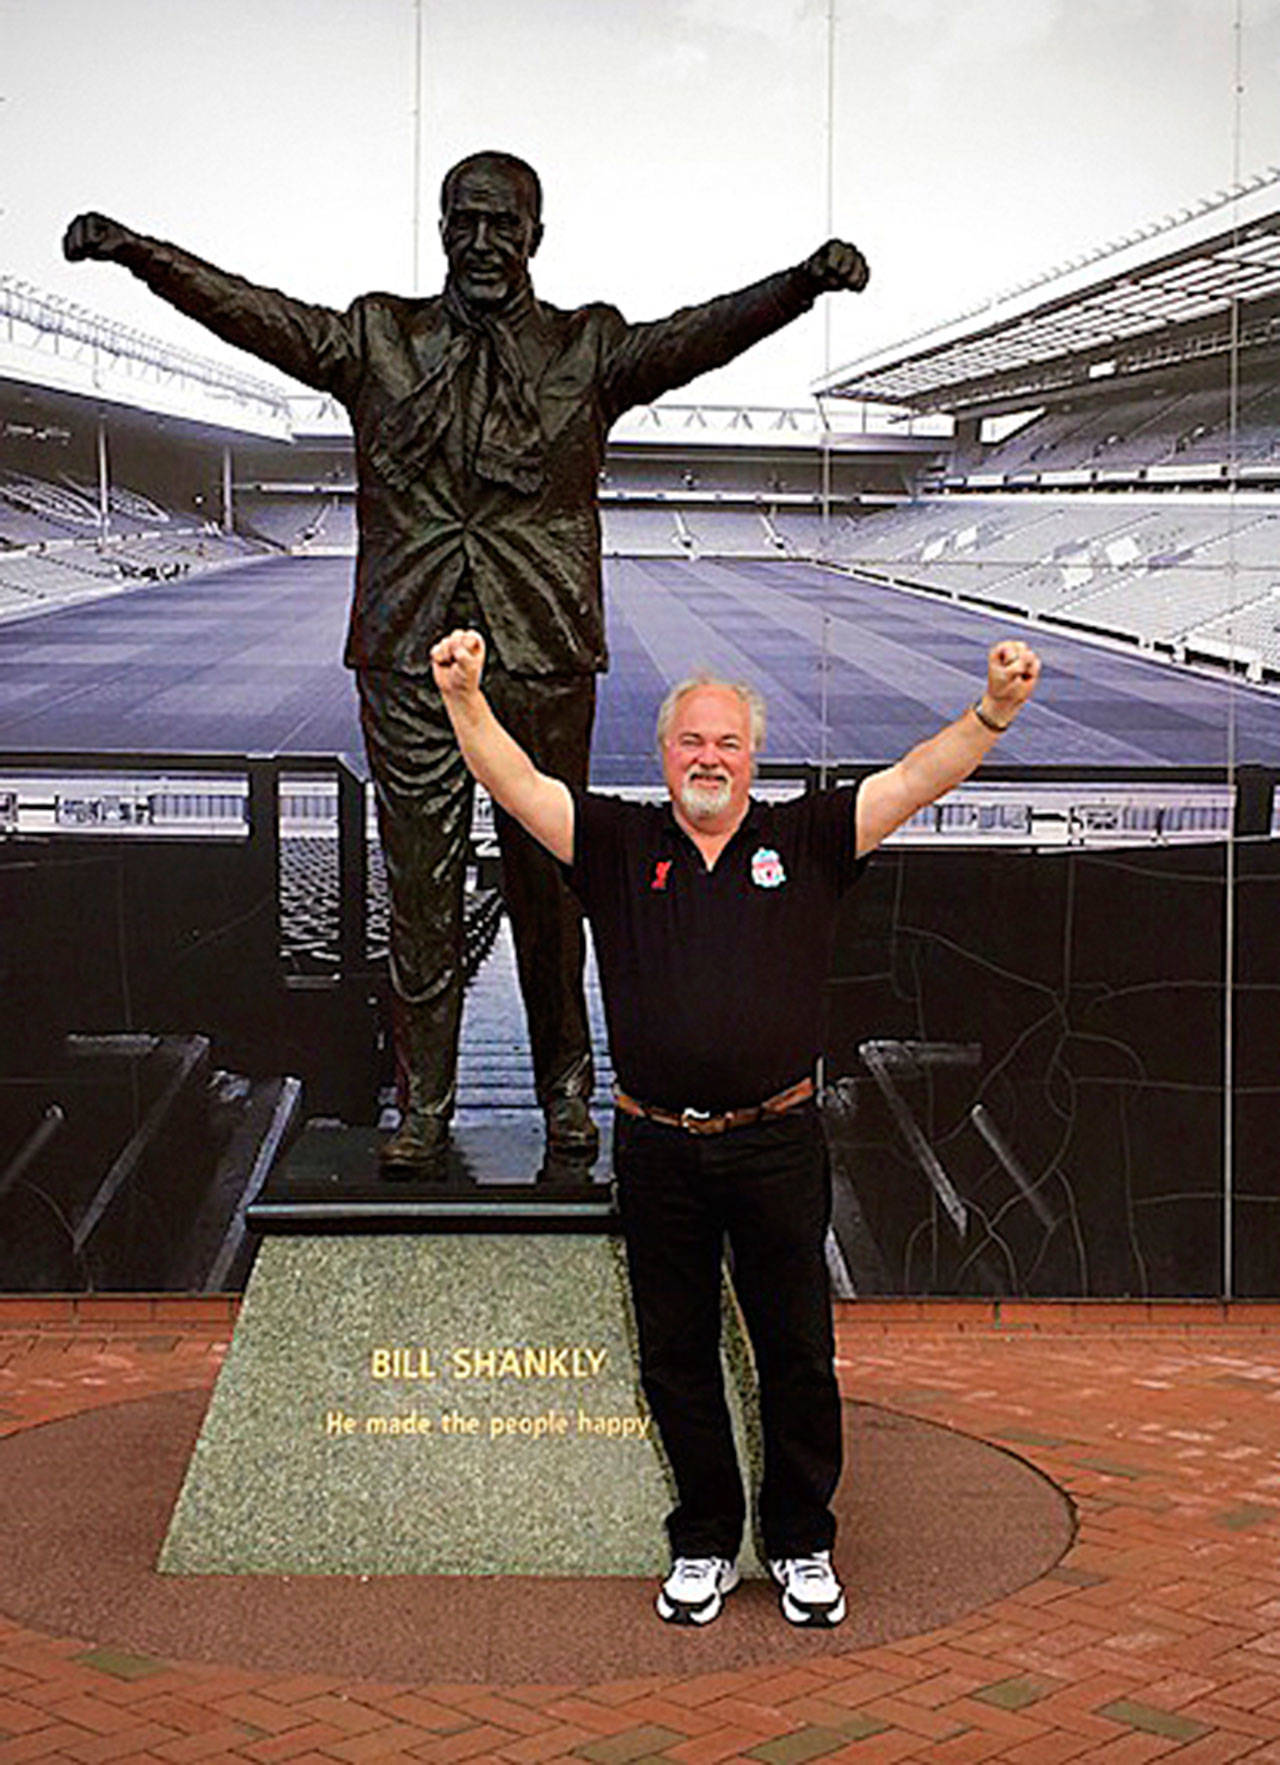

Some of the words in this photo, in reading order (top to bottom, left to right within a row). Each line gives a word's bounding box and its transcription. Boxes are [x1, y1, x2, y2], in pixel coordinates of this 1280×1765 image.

[372, 1348, 436, 1378] BILL
[452, 1348, 607, 1378] SHANKLY
[326, 1410, 355, 1434] He
[366, 1410, 431, 1434] made
[442, 1410, 478, 1434] the
[490, 1410, 568, 1439] people
[578, 1410, 651, 1440] happy
